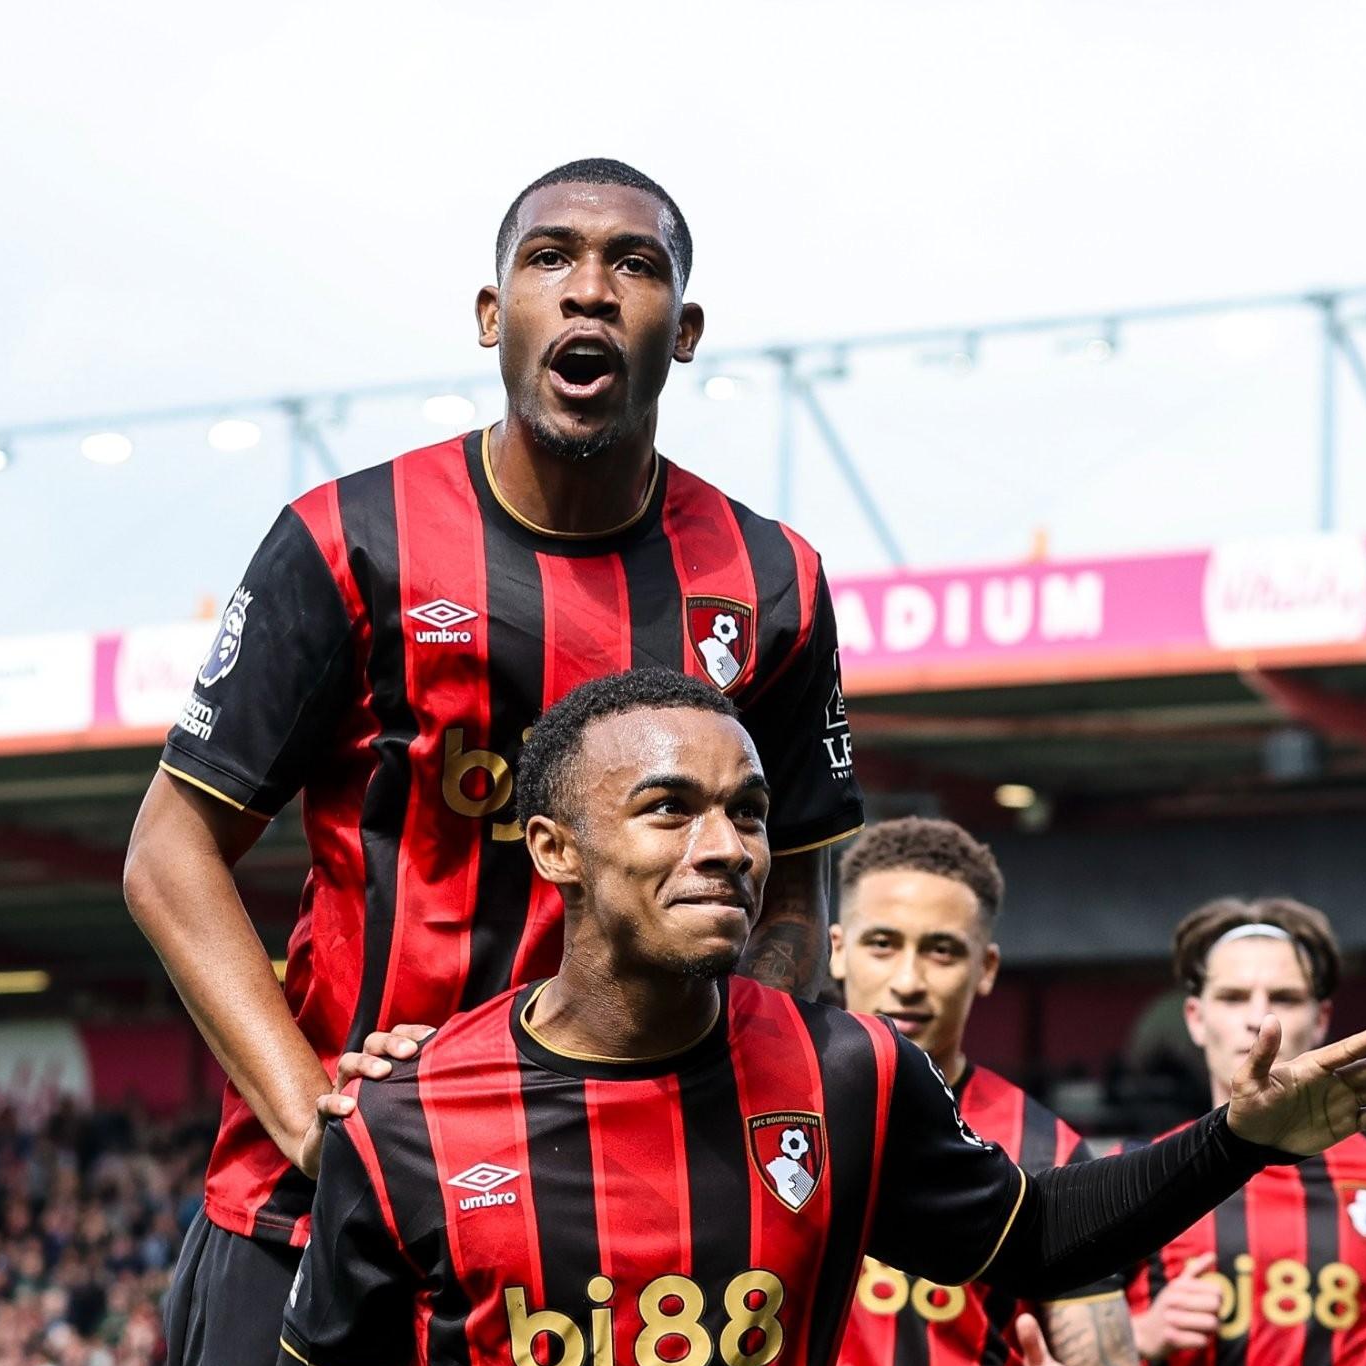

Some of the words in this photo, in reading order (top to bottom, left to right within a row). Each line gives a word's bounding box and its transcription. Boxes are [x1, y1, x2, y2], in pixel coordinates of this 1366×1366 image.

[416, 628, 472, 643] umbro
[752, 1118, 766, 1128] AFC
[766, 1115, 818, 1126] BOURNEMOUTH
[459, 1191, 517, 1211] umbro
